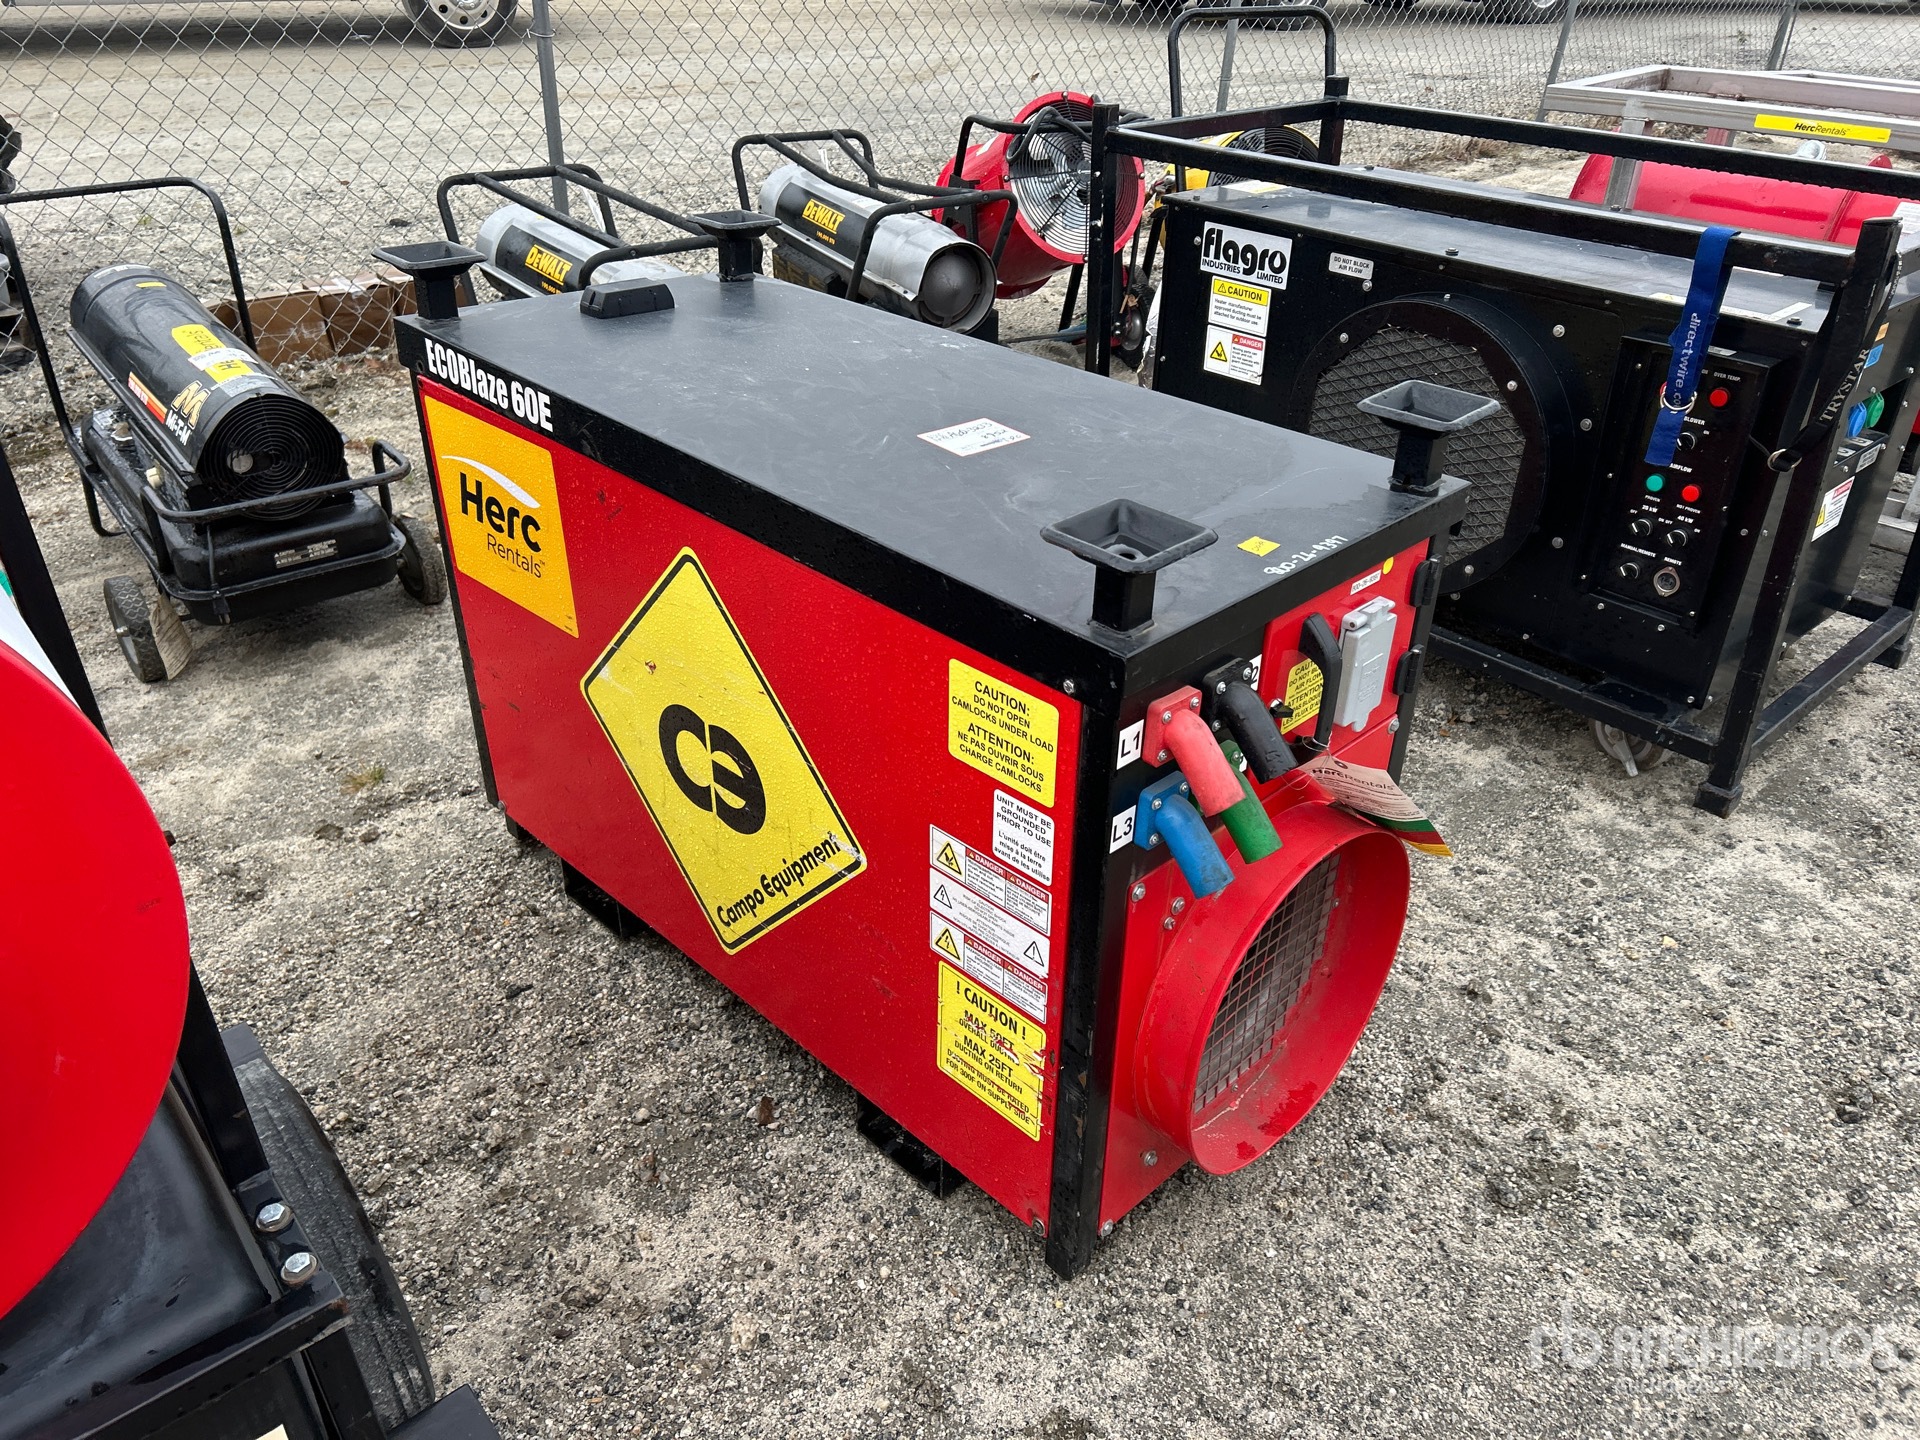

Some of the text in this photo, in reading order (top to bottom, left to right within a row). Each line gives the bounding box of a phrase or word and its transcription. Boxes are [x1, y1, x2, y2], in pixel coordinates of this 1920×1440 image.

[1203, 228, 1287, 276] flagro
[1353, 260, 1370, 269] BLOCK
[1202, 258, 1284, 285] INDUSTRIES LIMITED
[1348, 266, 1363, 274] FLOW
[1228, 286, 1263, 301] CAUTION
[1240, 338, 1262, 349] DANGER
[1673, 312, 1702, 408] directwire.co
[424, 337, 554, 432] ECOBlaze 60E
[1714, 371, 1727, 379] OVER
[1819, 348, 1870, 423] TRYSTAR
[1683, 416, 1705, 426] BLOWER
[459, 471, 542, 553] Herc
[1289, 671, 1310, 688] DO NOT
[1295, 661, 1314, 676] CAUT
[974, 695, 1031, 729] DO NOT OPEN
[975, 680, 1030, 716] CAUTION:
[952, 696, 1054, 753] CAMLOCKS UNDER LOAD
[957, 731, 1044, 782] NE PAS OUVRIR SOUS
[968, 722, 1034, 765] ATTENTION:
[1120, 731, 1141, 759] L1
[959, 743, 1042, 793] CHARGE CAMLOCKS
[996, 794, 1052, 829] UNIT MUST BE
[1001, 806, 1046, 835] GROUNDED
[996, 812, 1052, 847] PRIOR TO USE
[1112, 816, 1133, 843] L3
[994, 847, 1011, 859] avant
[1011, 856, 1020, 864] de
[999, 841, 1014, 853] mise
[1020, 843, 1033, 855] doit
[975, 855, 1005, 878] DANGER
[1015, 878, 1047, 901] DANGER
[716, 887, 763, 927] Campo
[973, 940, 1003, 966] DANGER
[1013, 967, 1044, 992] DANGER
[964, 987, 1018, 1035] CAUTION
[954, 1040, 1023, 1095] DUCTING ON RETURN
[964, 1035, 1014, 1078] MAX 25FT
[946, 1057, 959, 1072] FOR
[960, 1068, 976, 1083] 300F
[976, 1080, 987, 1092] ON
[987, 1088, 1012, 1111] SUPPLY
